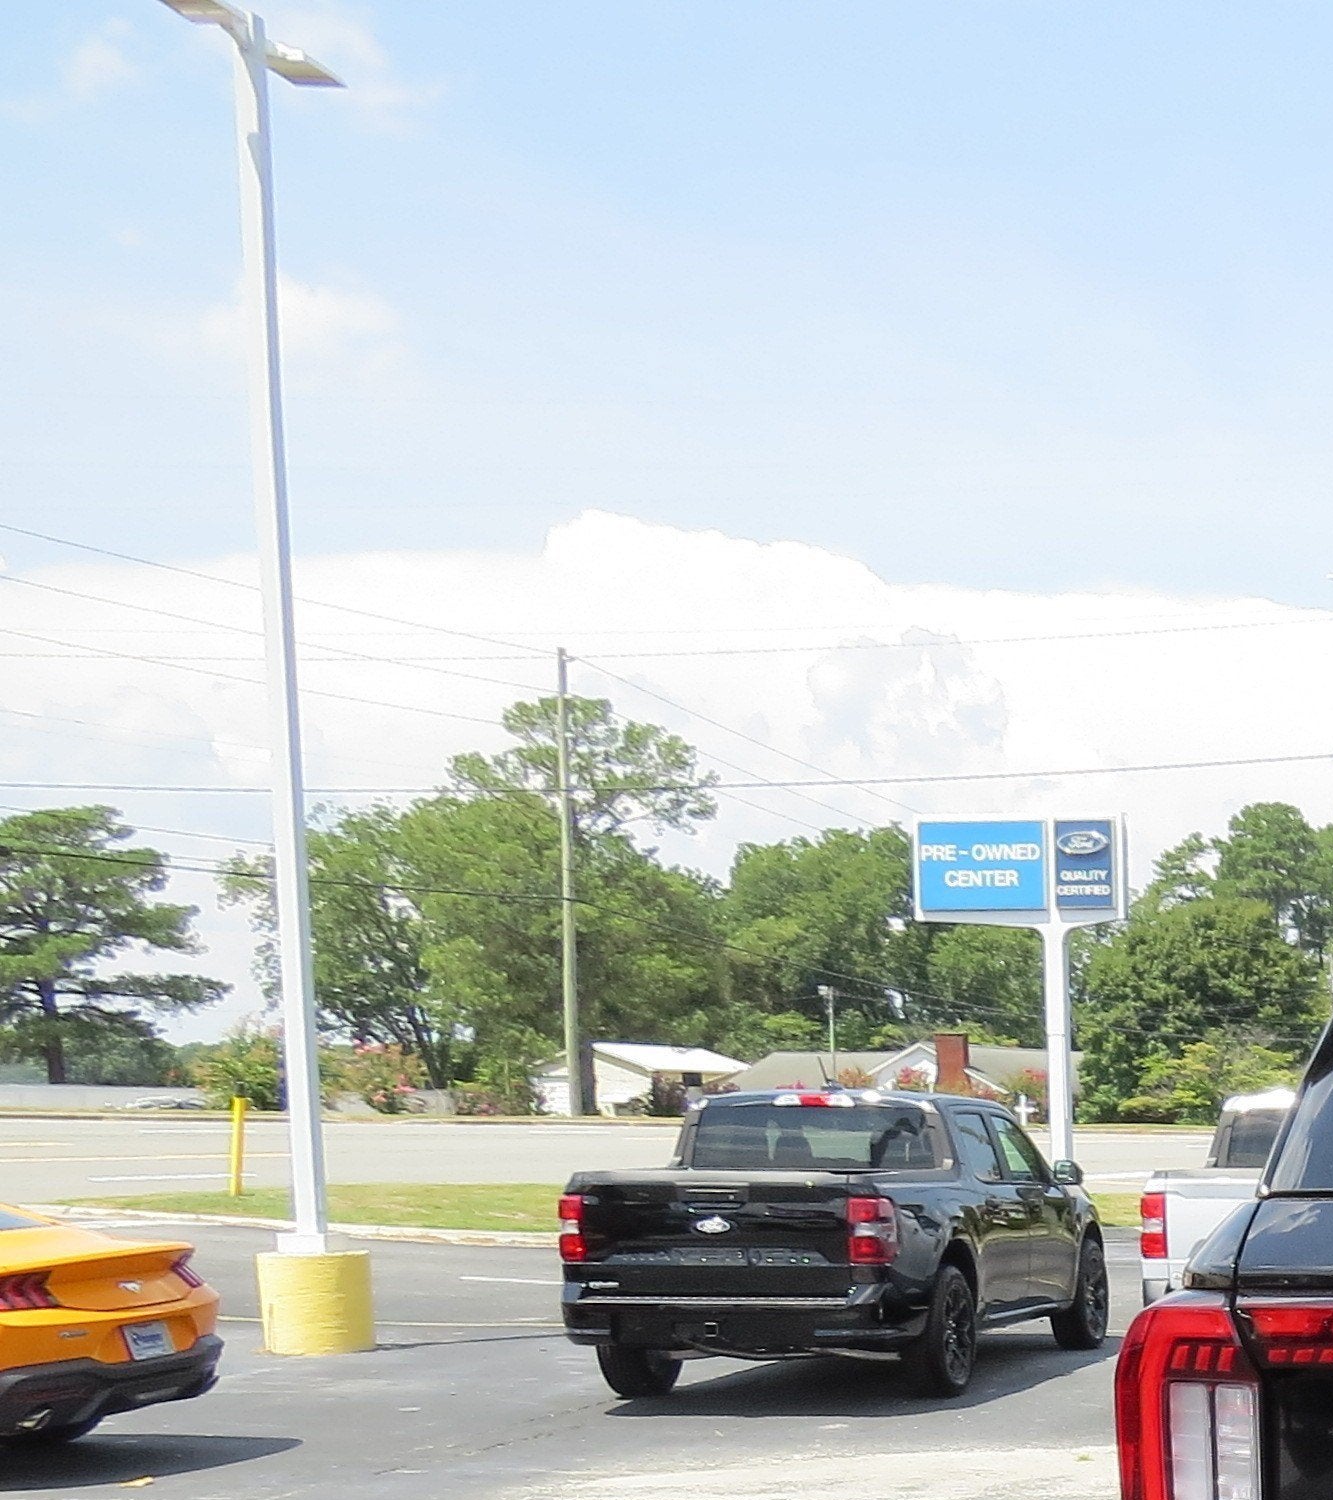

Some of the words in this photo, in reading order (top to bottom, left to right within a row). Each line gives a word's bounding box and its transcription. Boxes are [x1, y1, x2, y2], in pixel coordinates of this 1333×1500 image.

[944, 869, 1020, 888] CENTER
[1060, 869, 1109, 881] QUALITY
[1056, 884, 1111, 896] CERTIFIED
